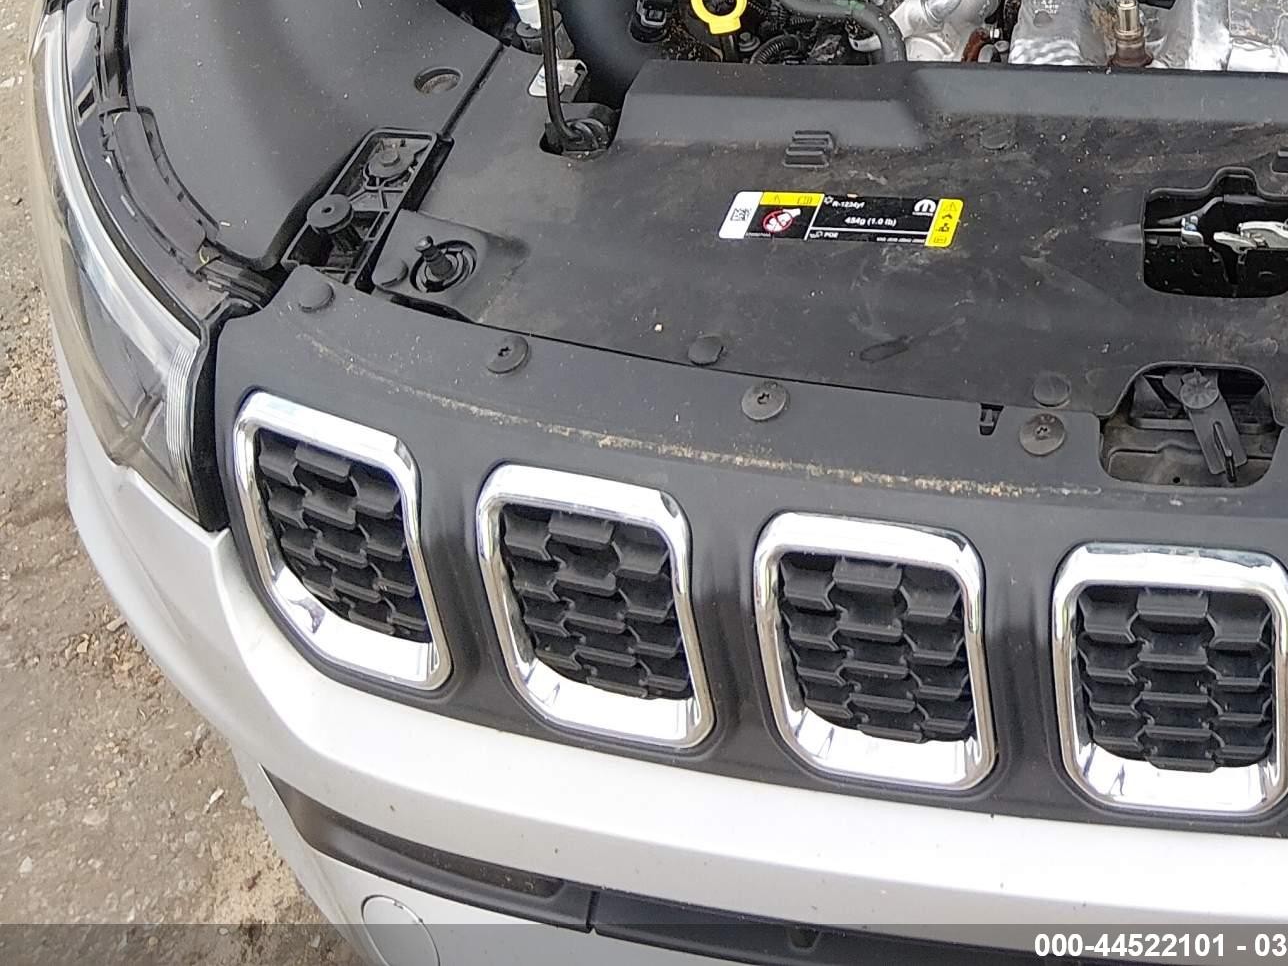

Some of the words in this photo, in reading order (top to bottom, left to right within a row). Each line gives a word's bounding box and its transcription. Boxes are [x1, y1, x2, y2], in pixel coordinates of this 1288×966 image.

[831, 200, 866, 210] R-1234yf
[844, 216, 867, 226] 454g
[867, 217, 884, 227] (1.0
[884, 218, 897, 227] lb)
